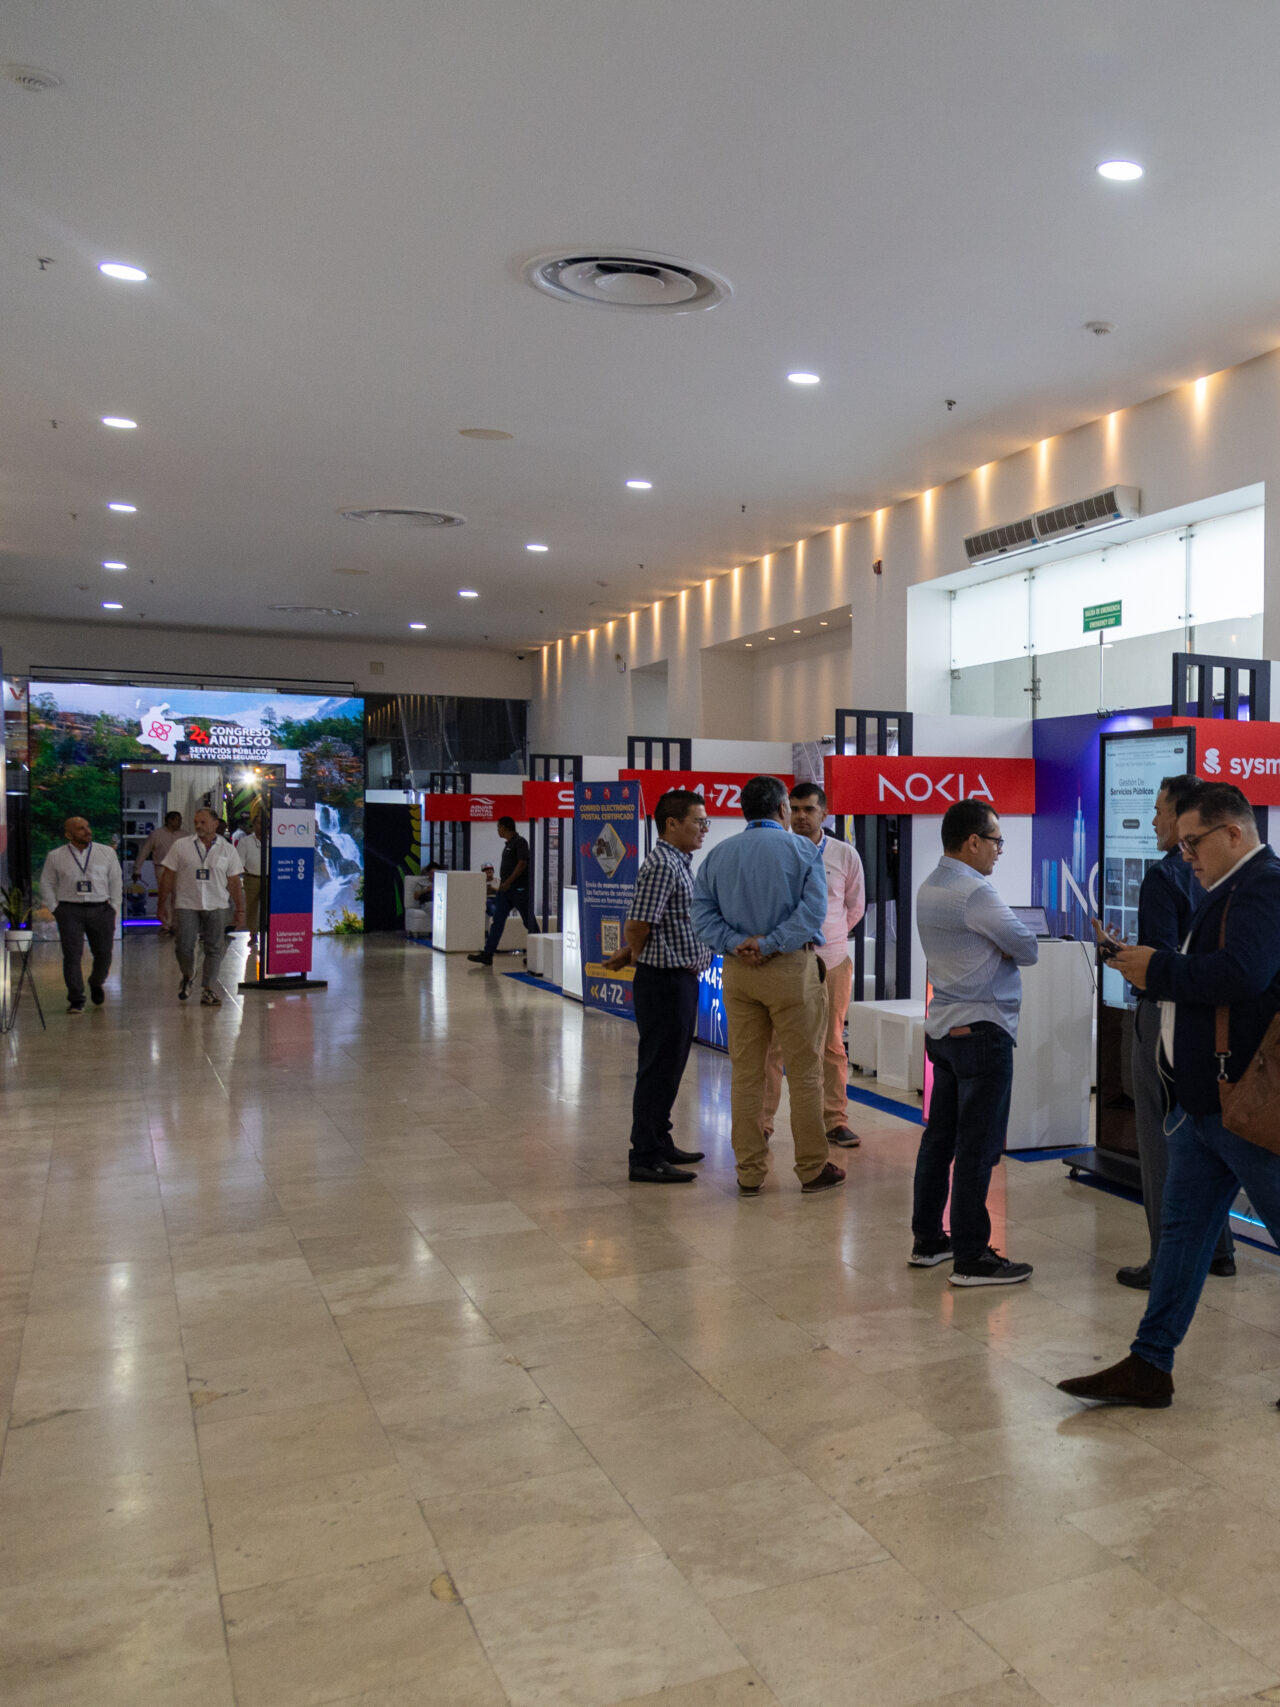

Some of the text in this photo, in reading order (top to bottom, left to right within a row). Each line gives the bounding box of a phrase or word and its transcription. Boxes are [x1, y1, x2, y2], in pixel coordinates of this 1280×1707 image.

[209, 726, 271, 737] CONGRESO
[209, 735, 272, 747] ANDESCO
[189, 746, 271, 756] SERVICIOS PÚBLICOS
[878, 772, 994, 802] NOKIA
[1110, 788, 1132, 796] Servicios
[277, 821, 310, 835] enel
